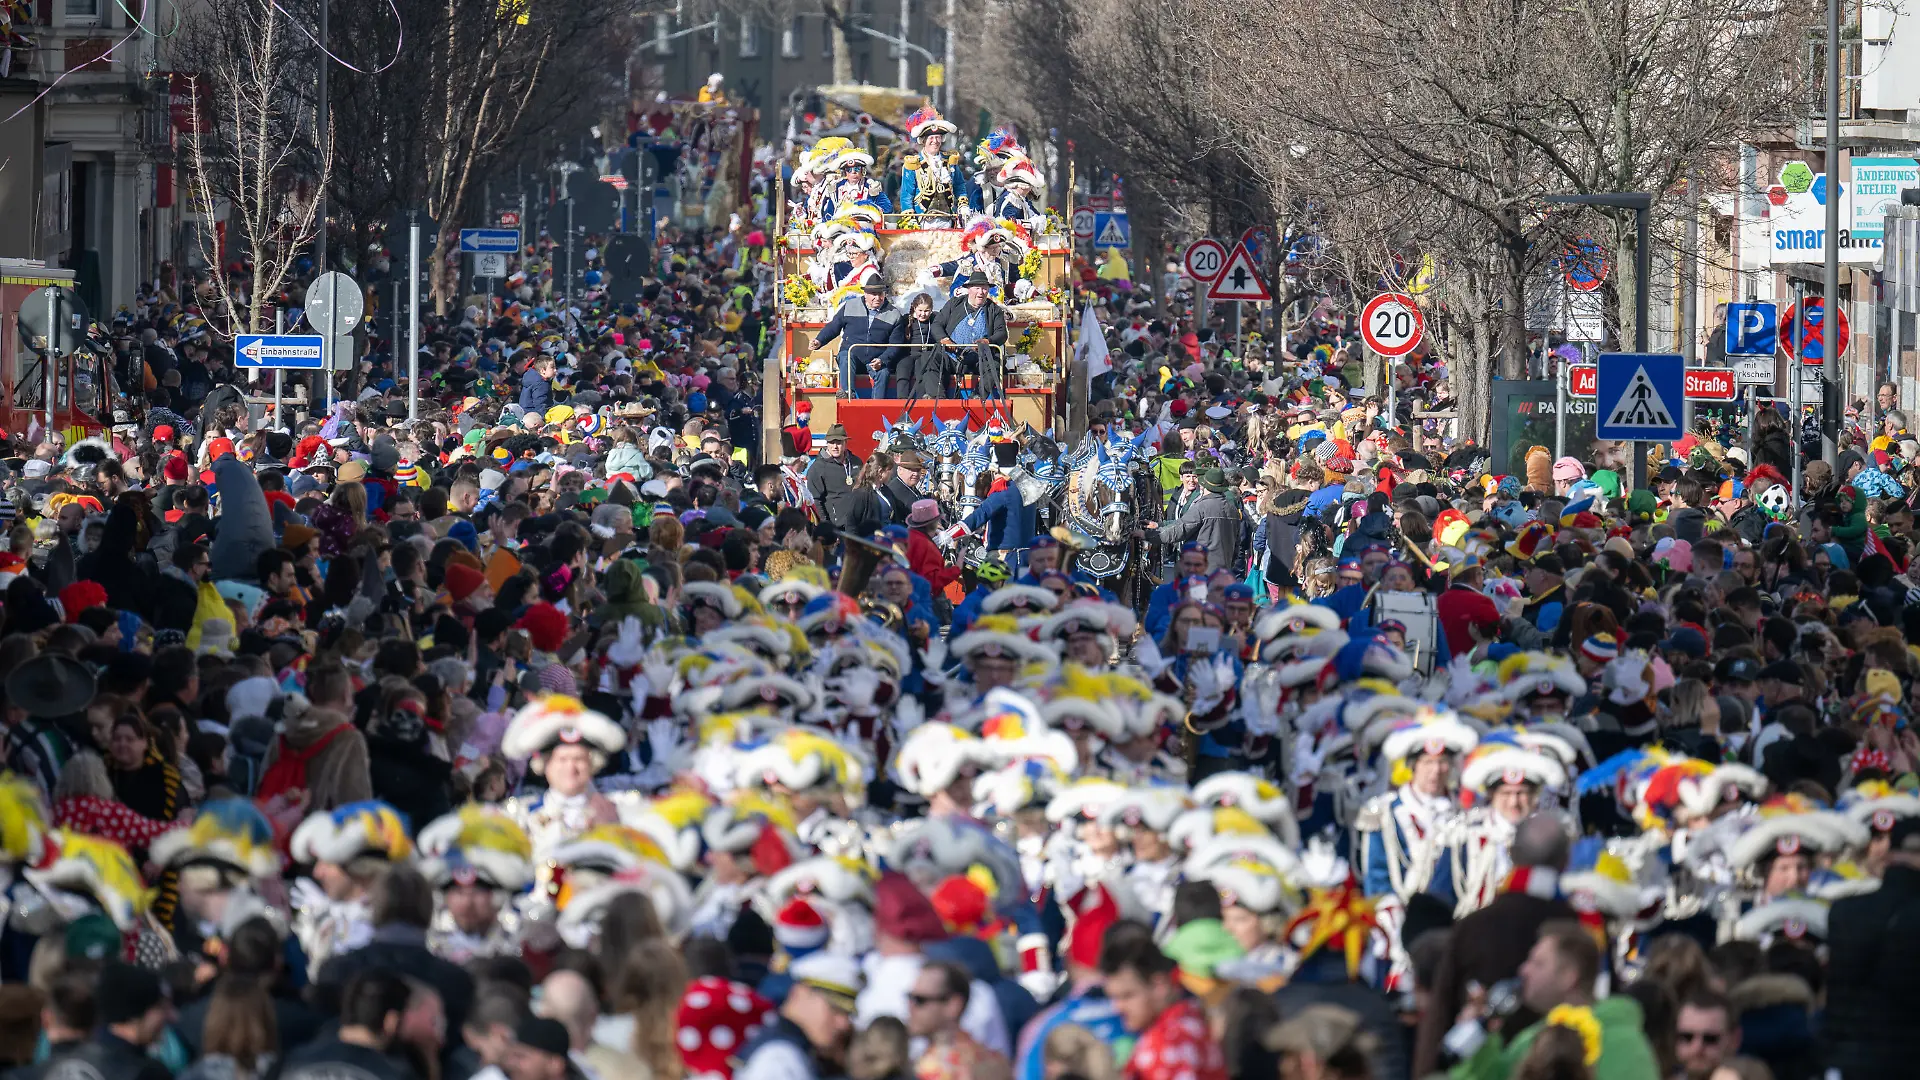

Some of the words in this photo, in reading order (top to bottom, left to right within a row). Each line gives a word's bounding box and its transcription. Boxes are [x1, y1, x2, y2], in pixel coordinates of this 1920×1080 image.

[1856, 168, 1916, 181] ÄNDERUNGS
[1856, 184, 1897, 195] ATELIER
[1075, 215, 1093, 229] 20
[1195, 251, 1218, 270] 20
[1375, 311, 1410, 338] 20
[1738, 310, 1765, 347] P
[260, 347, 318, 356] Einbahnstraße
[1579, 373, 1596, 389] Ad
[1686, 375, 1728, 392] Straße
